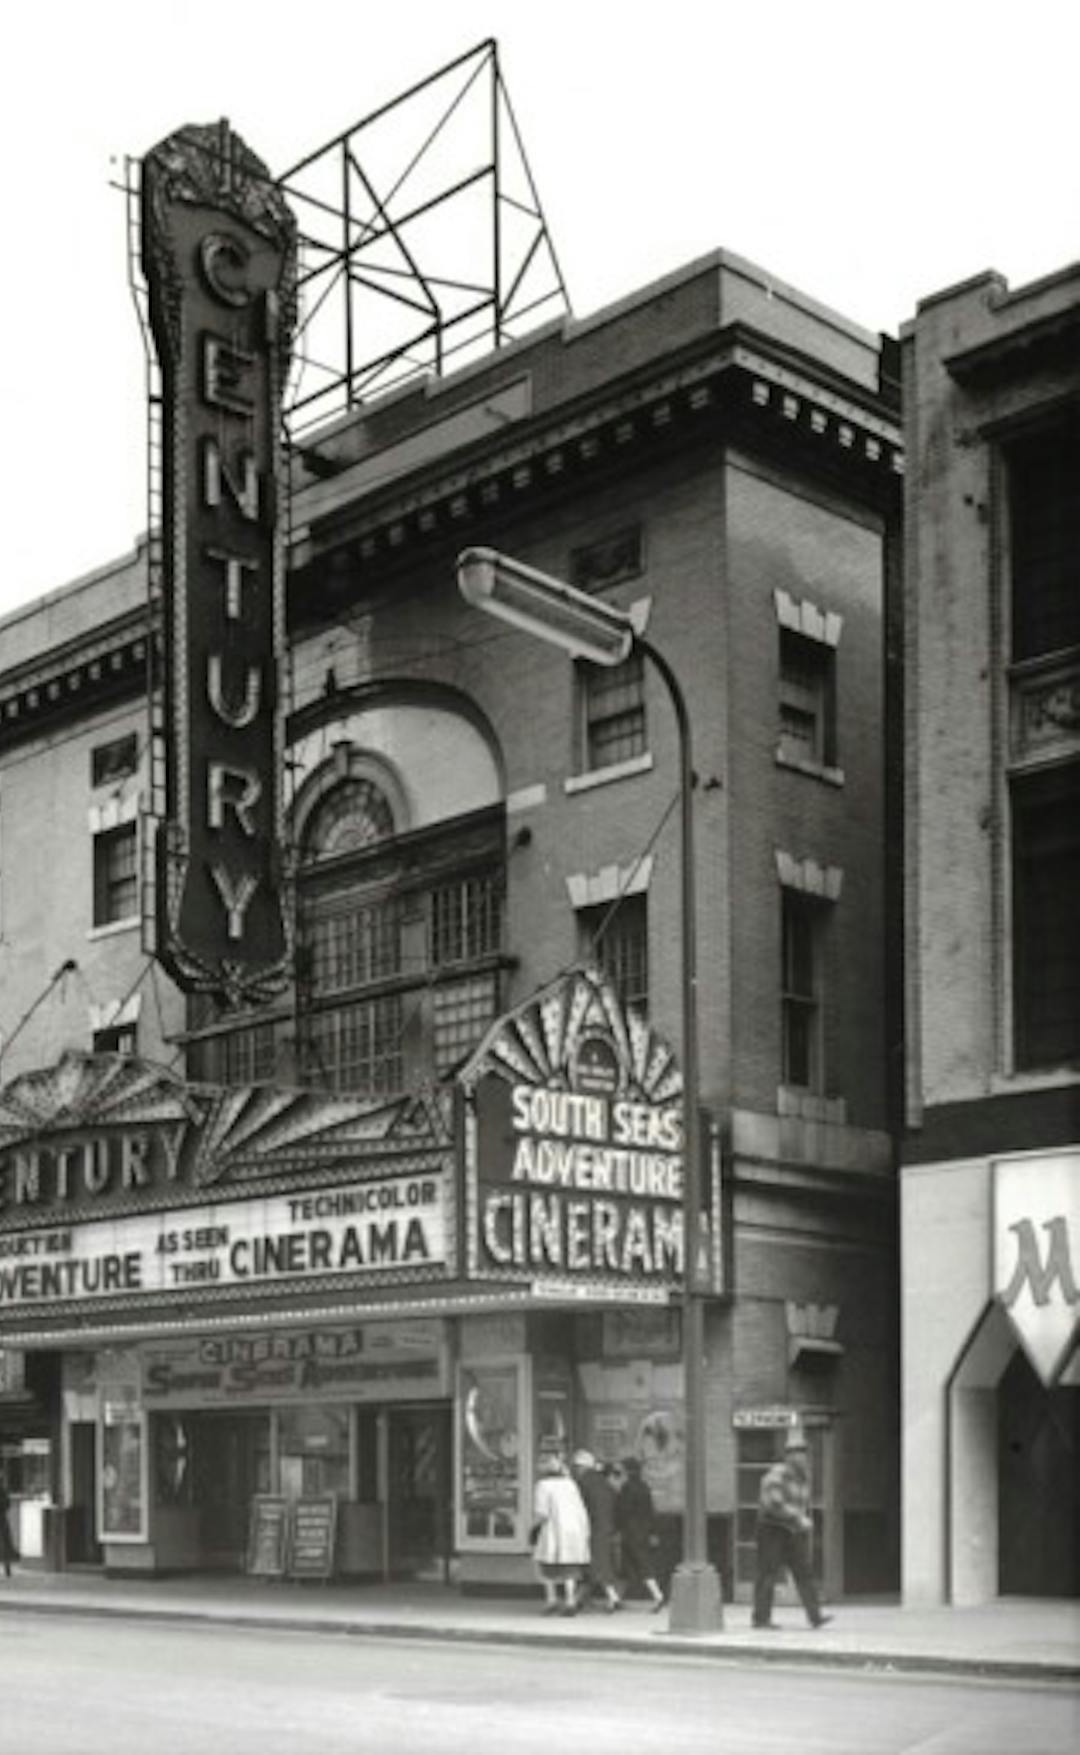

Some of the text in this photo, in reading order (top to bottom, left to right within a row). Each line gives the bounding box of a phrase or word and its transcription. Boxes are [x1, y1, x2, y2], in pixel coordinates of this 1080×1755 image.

[198, 231, 262, 940] CENTURY
[511, 1085, 682, 1150] SOUTH SEAS
[511, 1137, 682, 1199] ADVENTURE
[287, 1181, 438, 1223] TECHNICOLOR
[155, 1226, 230, 1254] AS SEEN
[172, 1258, 220, 1283] THRU
[230, 1216, 430, 1278] CINERAMA
